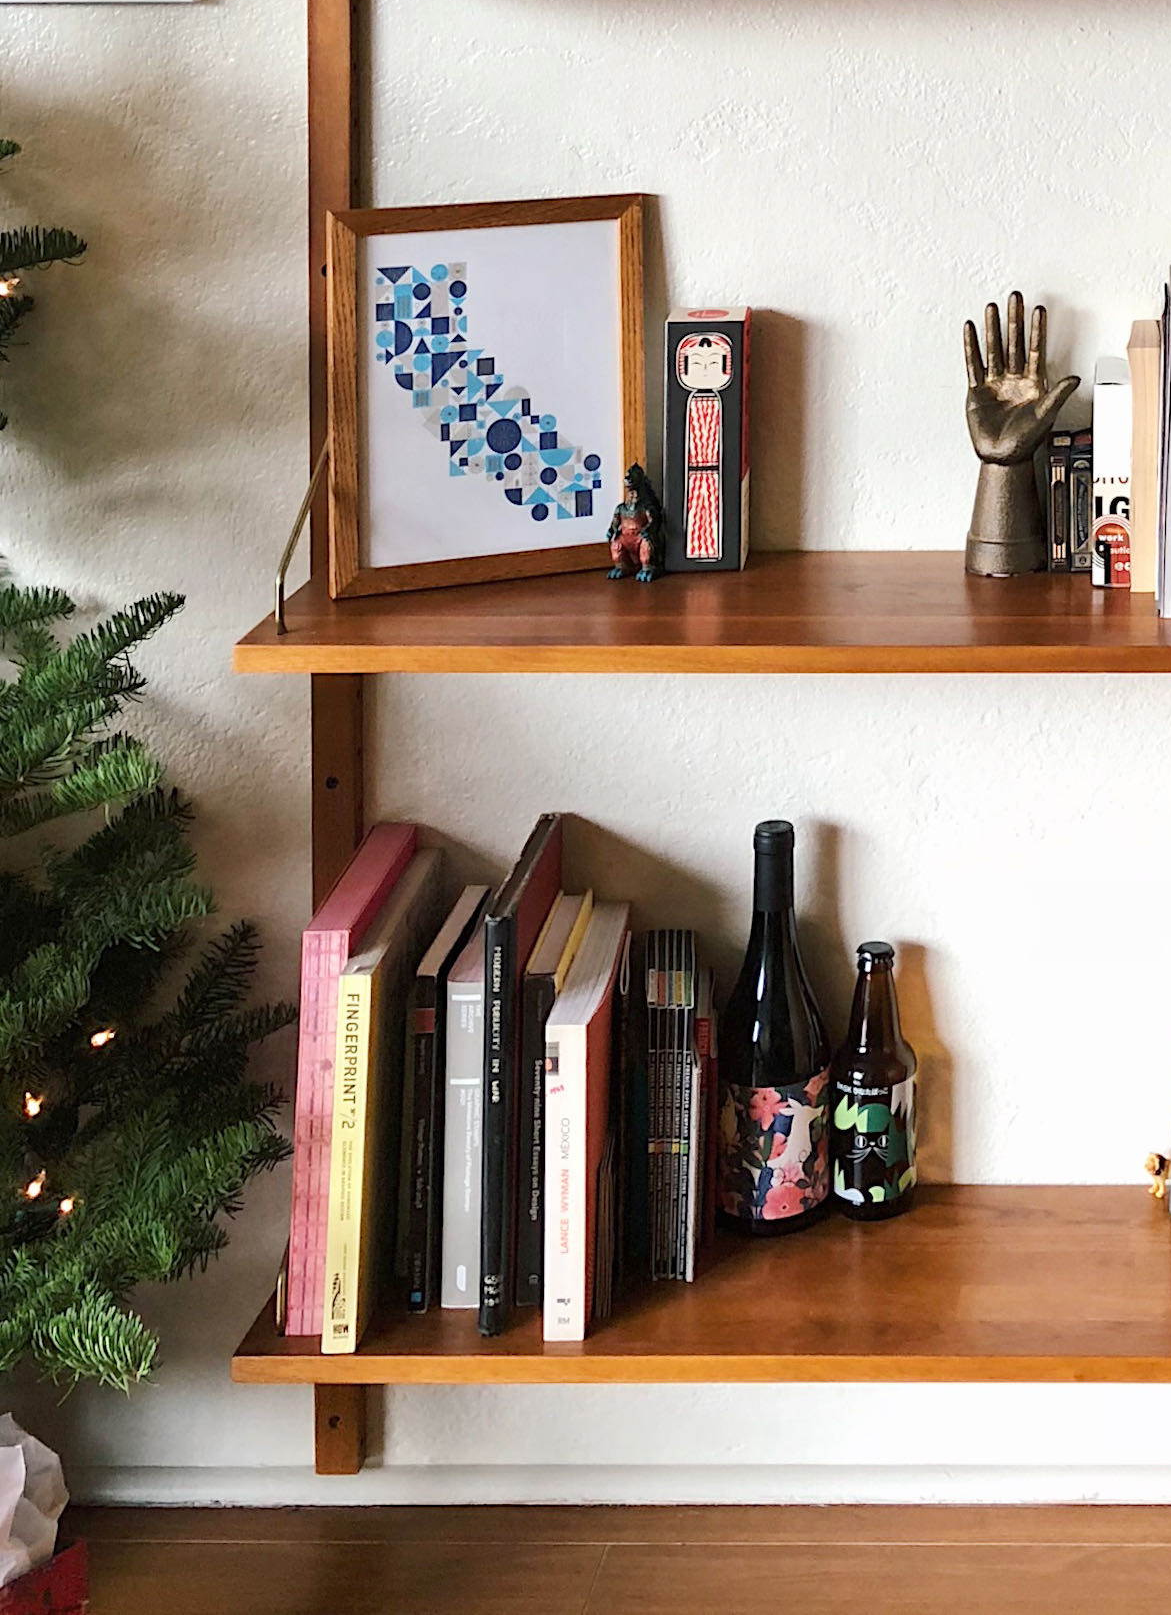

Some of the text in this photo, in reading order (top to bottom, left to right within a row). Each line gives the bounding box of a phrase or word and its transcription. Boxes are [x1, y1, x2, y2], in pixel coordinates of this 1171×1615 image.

[1098, 534, 1124, 542] work
[491, 945, 502, 1104] MODERN PUBLICITY IN WAR
[343, 993, 360, 1104] FINGERPRINT
[531, 1120, 540, 1145] Short
[530, 1146, 540, 1175] Essays
[559, 1117, 570, 1255] LANCE WYMAN MÉXICO
[529, 1190, 540, 1221] Design
